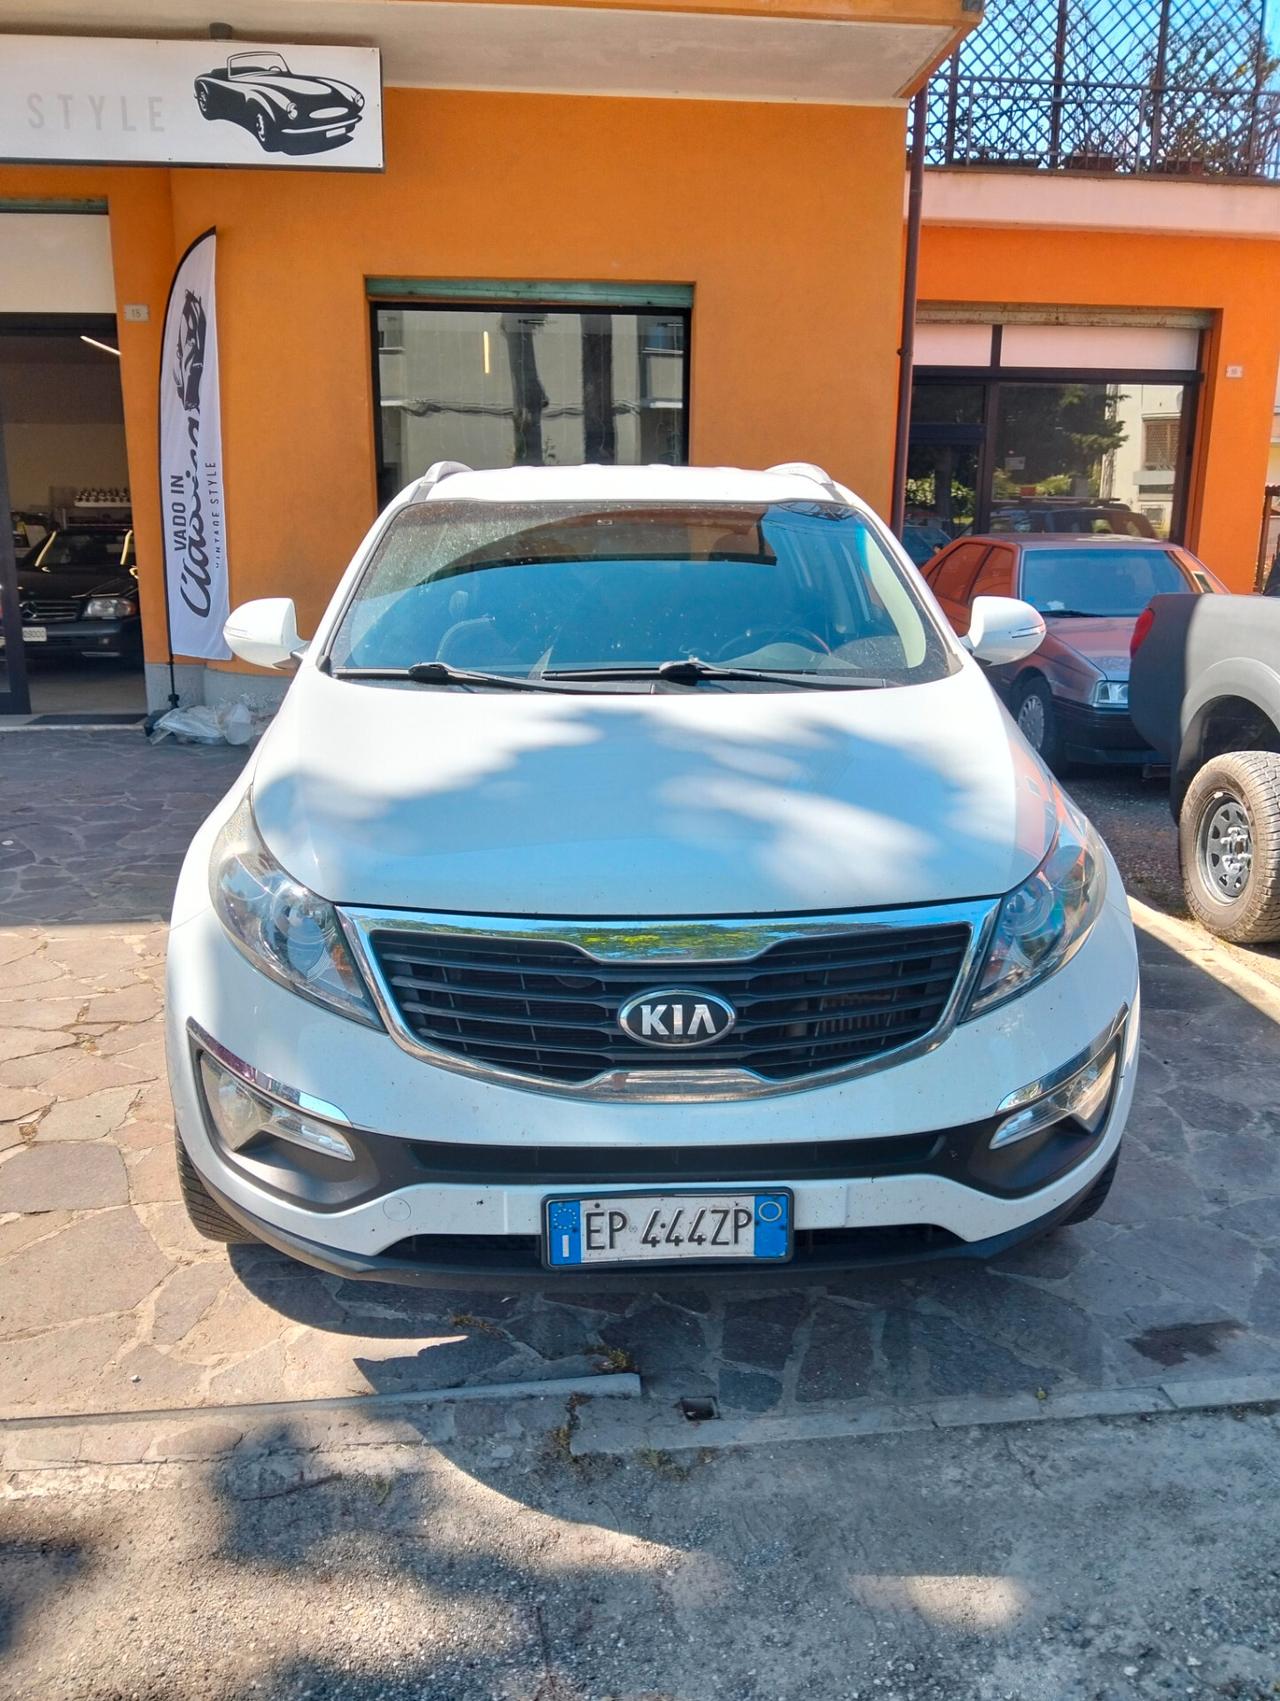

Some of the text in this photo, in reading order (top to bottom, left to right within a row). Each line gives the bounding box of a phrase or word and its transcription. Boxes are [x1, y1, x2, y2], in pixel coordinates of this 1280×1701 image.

[27, 92, 165, 132] STYLE
[205, 461, 219, 504] STYLE
[170, 475, 187, 551] VADO IN
[641, 1004, 717, 1035] KIA
[586, 1210, 627, 1251] EP
[641, 1207, 753, 1248] 444ZP
